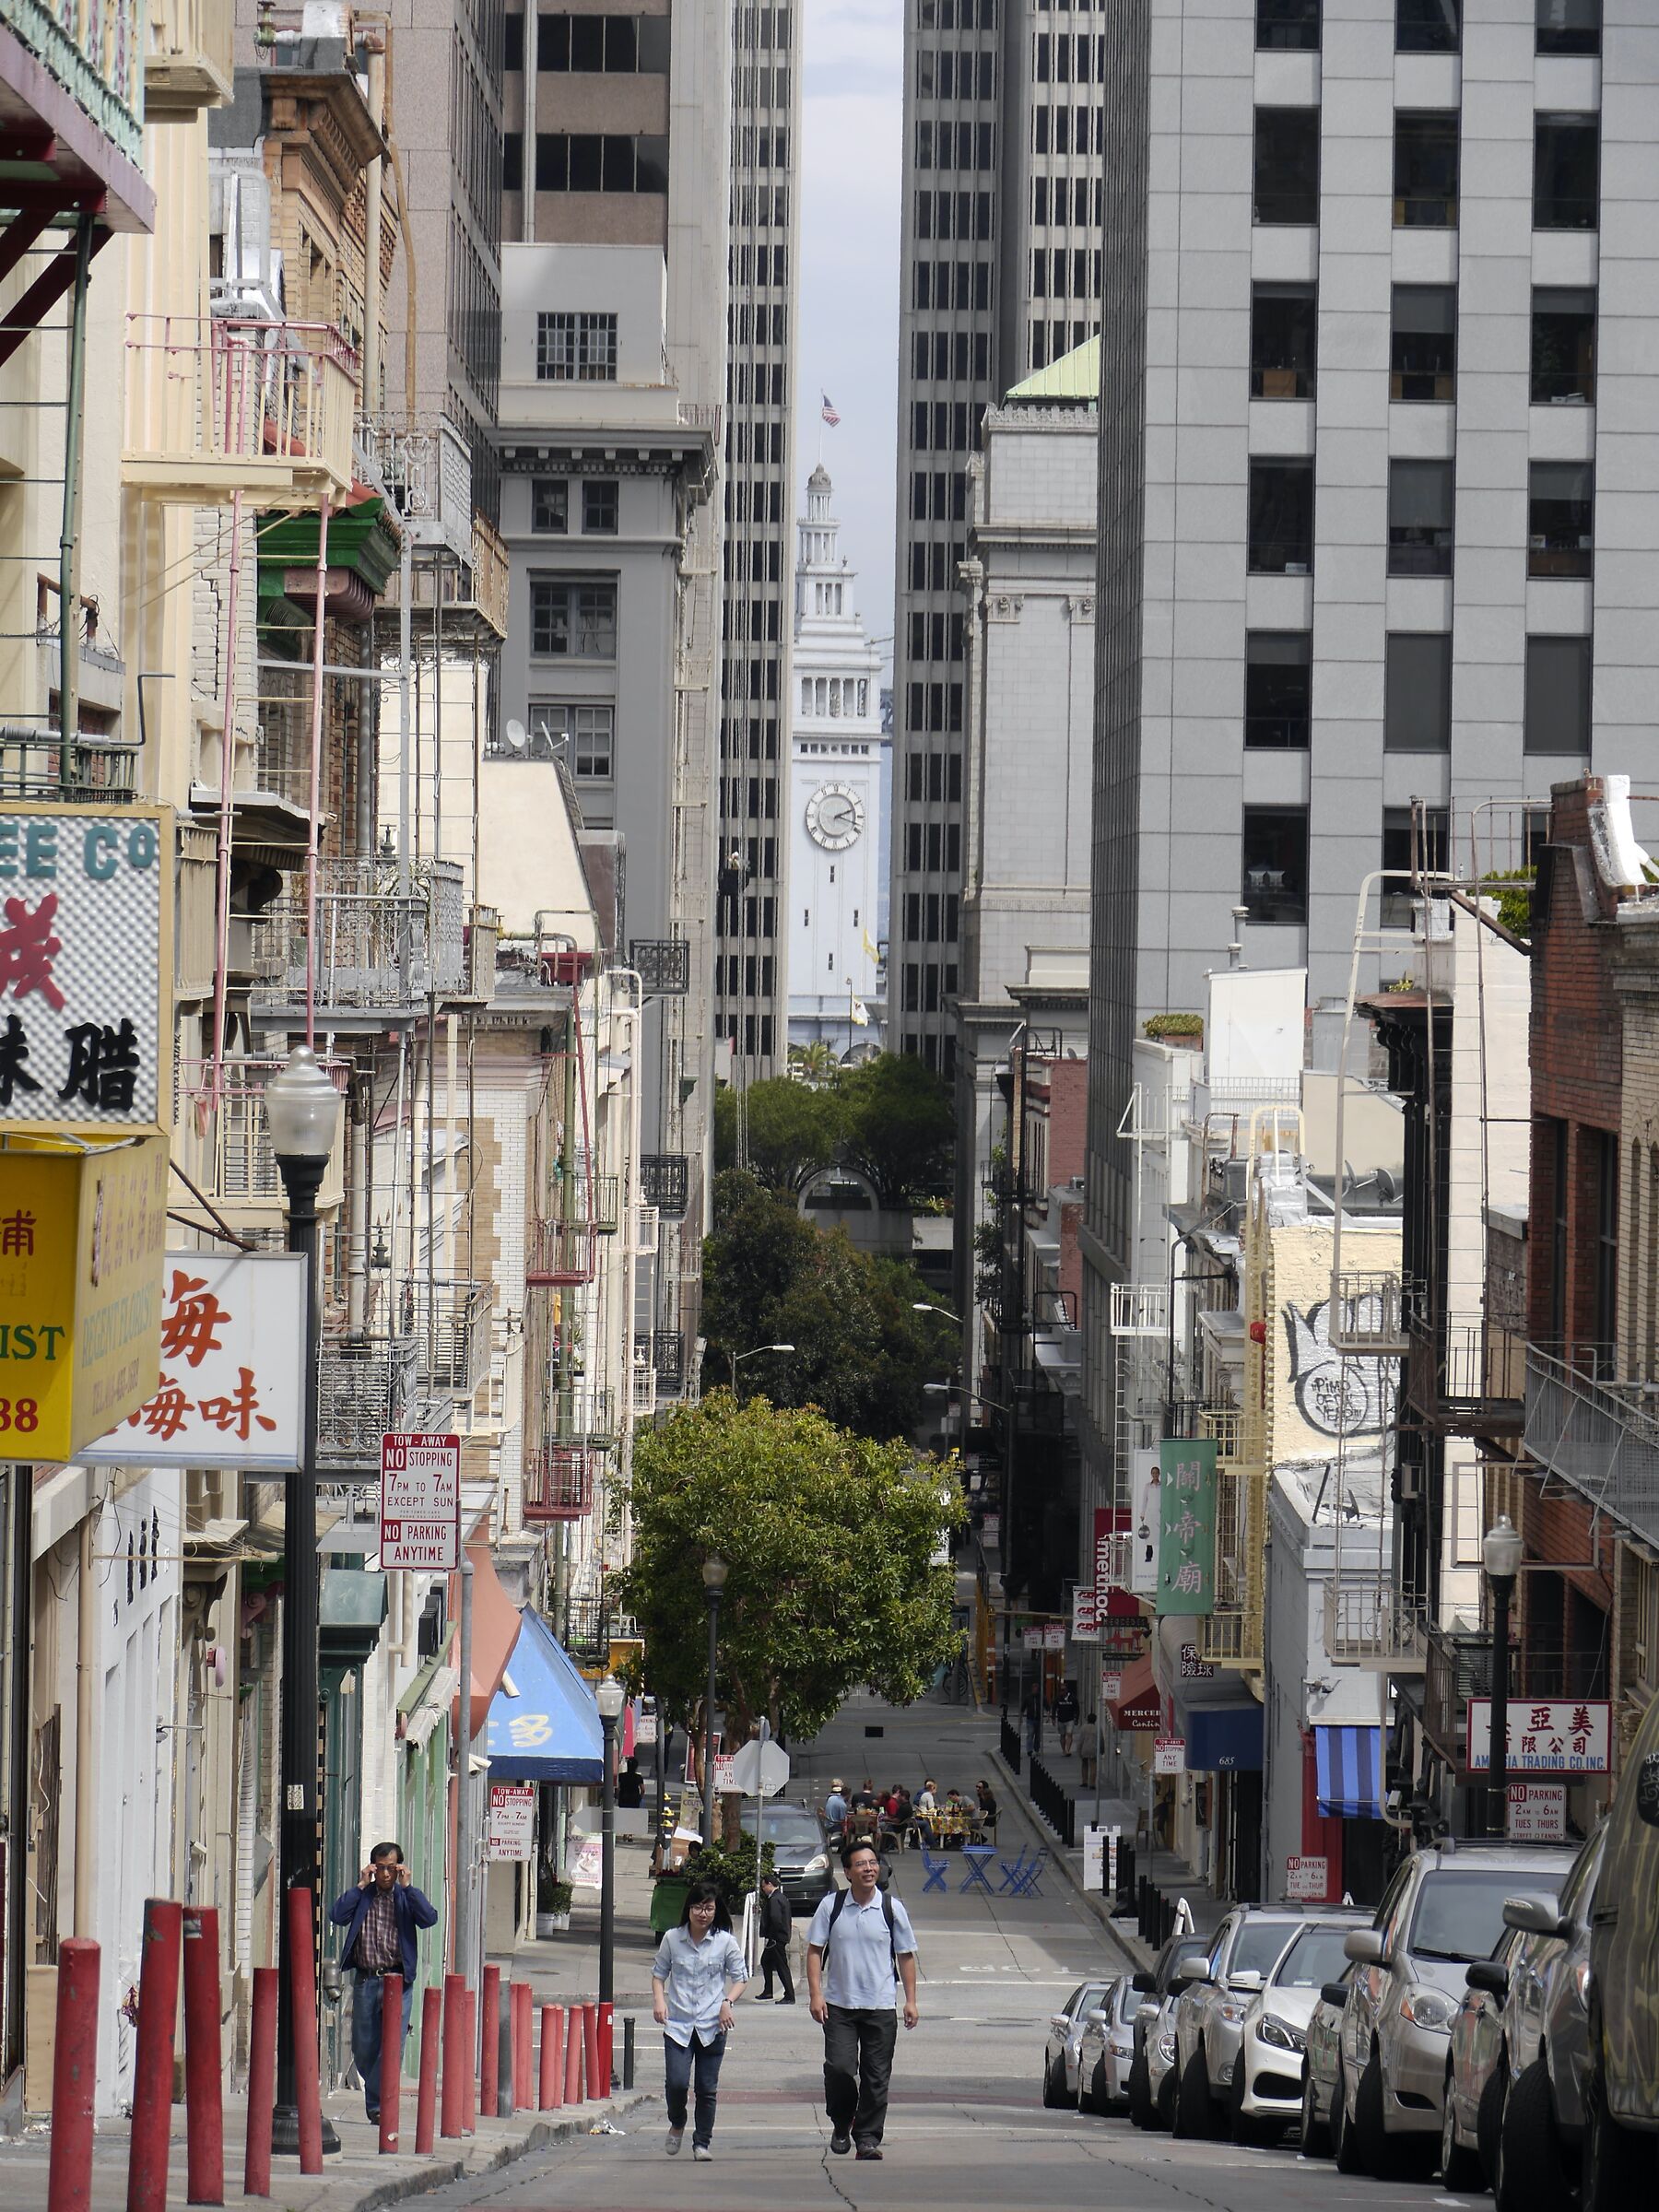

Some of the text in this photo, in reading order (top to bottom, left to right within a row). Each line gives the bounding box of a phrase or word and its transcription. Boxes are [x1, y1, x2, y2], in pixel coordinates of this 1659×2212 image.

[386, 1449, 453, 1467] NO STOPPING
[389, 1474, 453, 1492] 7PM TO 7AM
[388, 1498, 453, 1507] EXCEPT SUN
[384, 1525, 446, 1540] NO PARKING
[394, 1547, 443, 1561] ANYTIME
[1218, 1756, 1235, 1765] 685
[1522, 1756, 1565, 1769] TRADING
[1511, 1785, 1562, 1801] NO PARKING
[493, 1795, 532, 1806] NO STOPPING
[1515, 1804, 1531, 1815] 2AM
[1543, 1805, 1559, 1815] 6AM
[1515, 1819, 1559, 1830] TUES THURS
[1288, 1858, 1325, 1869] NO PARKING
